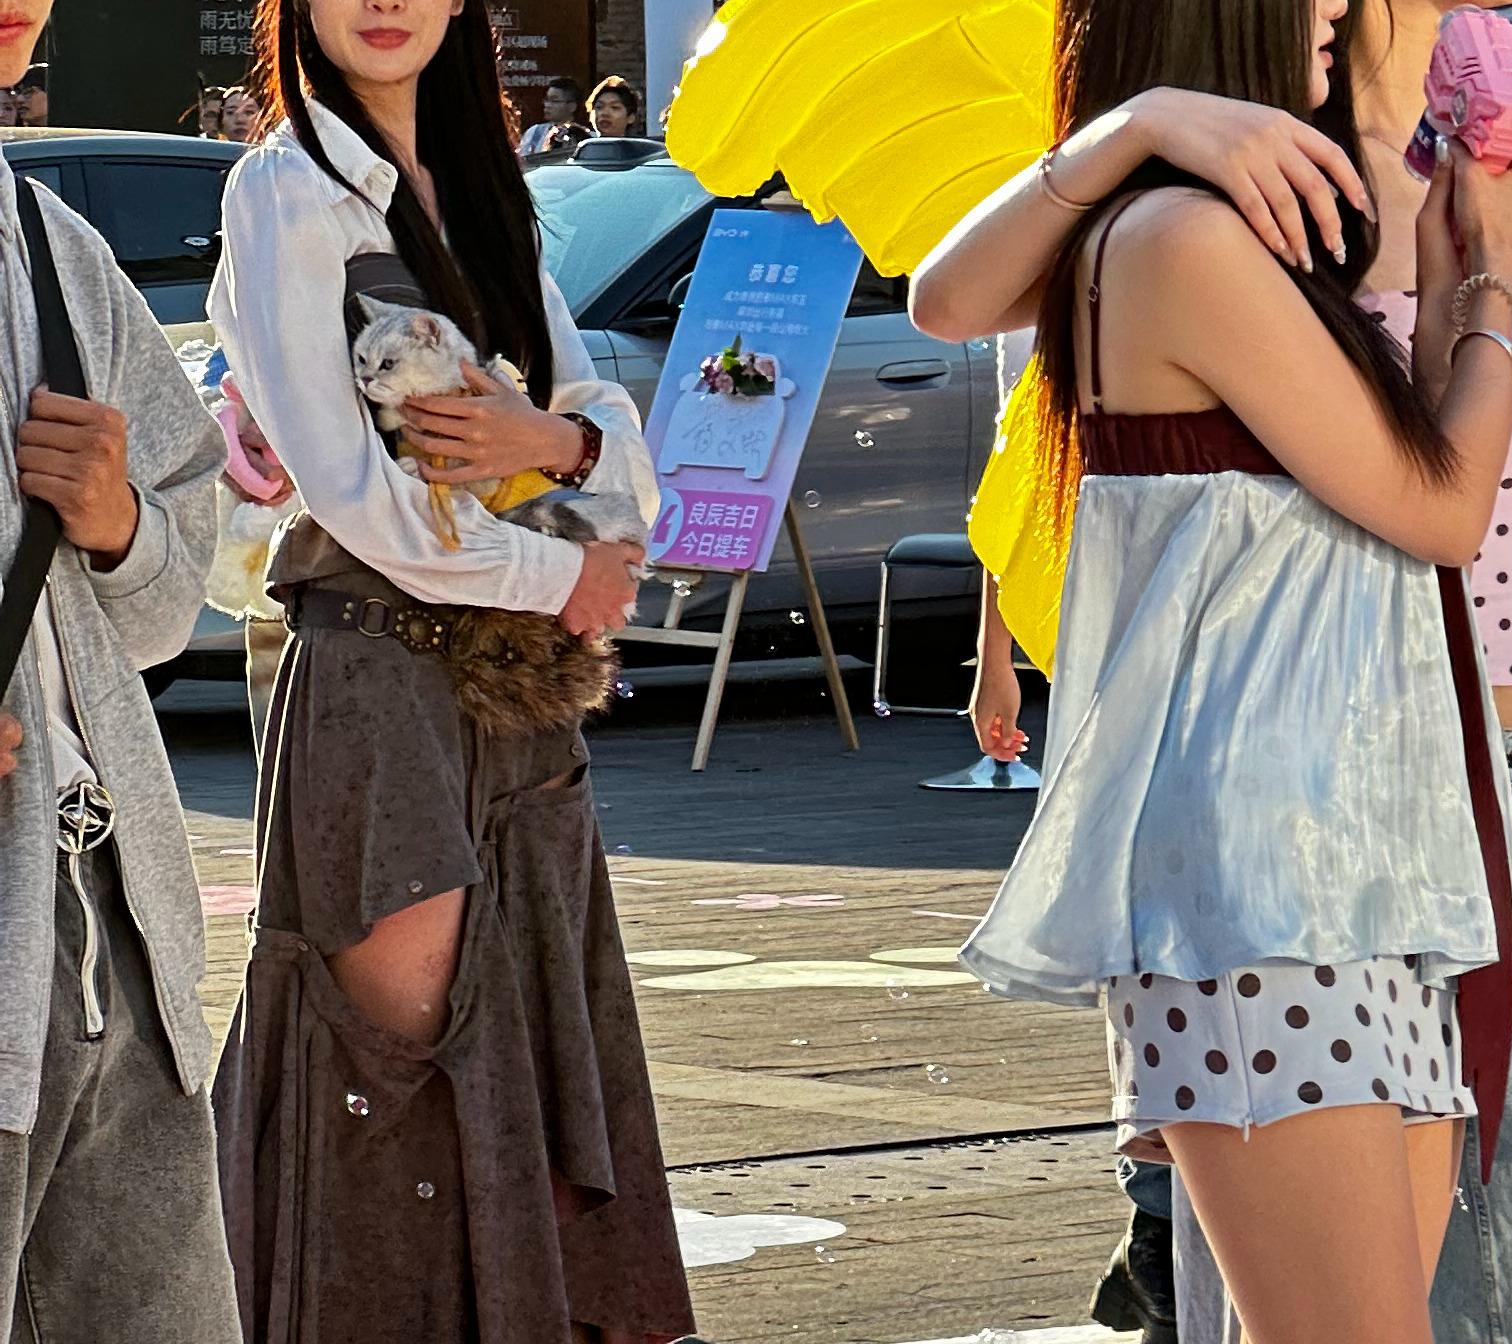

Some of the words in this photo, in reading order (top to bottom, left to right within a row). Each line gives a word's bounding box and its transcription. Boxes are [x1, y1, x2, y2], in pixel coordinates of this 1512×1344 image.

[688, 502, 759, 529] 良辰吉日
[680, 532, 751, 560] 今日提车
